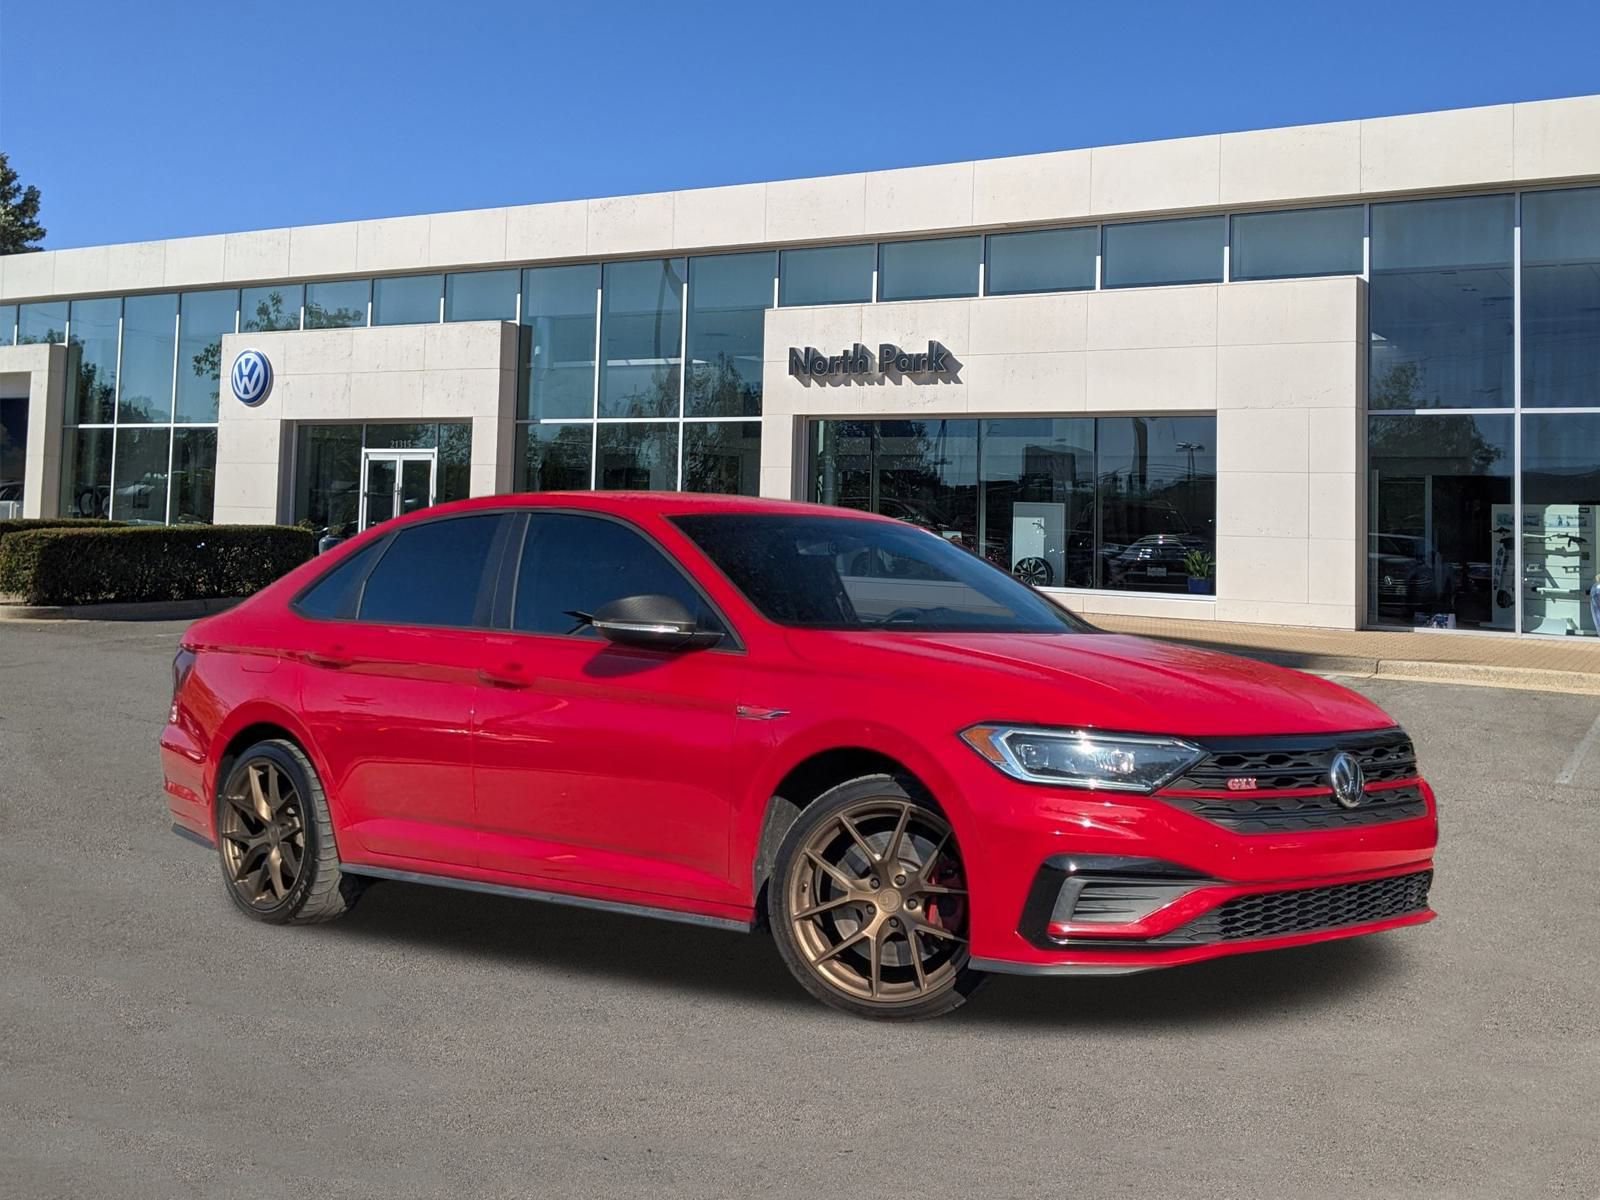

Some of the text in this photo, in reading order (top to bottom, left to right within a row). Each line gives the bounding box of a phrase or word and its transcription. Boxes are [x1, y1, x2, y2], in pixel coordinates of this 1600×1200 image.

[232, 350, 269, 403] VW
[788, 340, 948, 376] North Park
